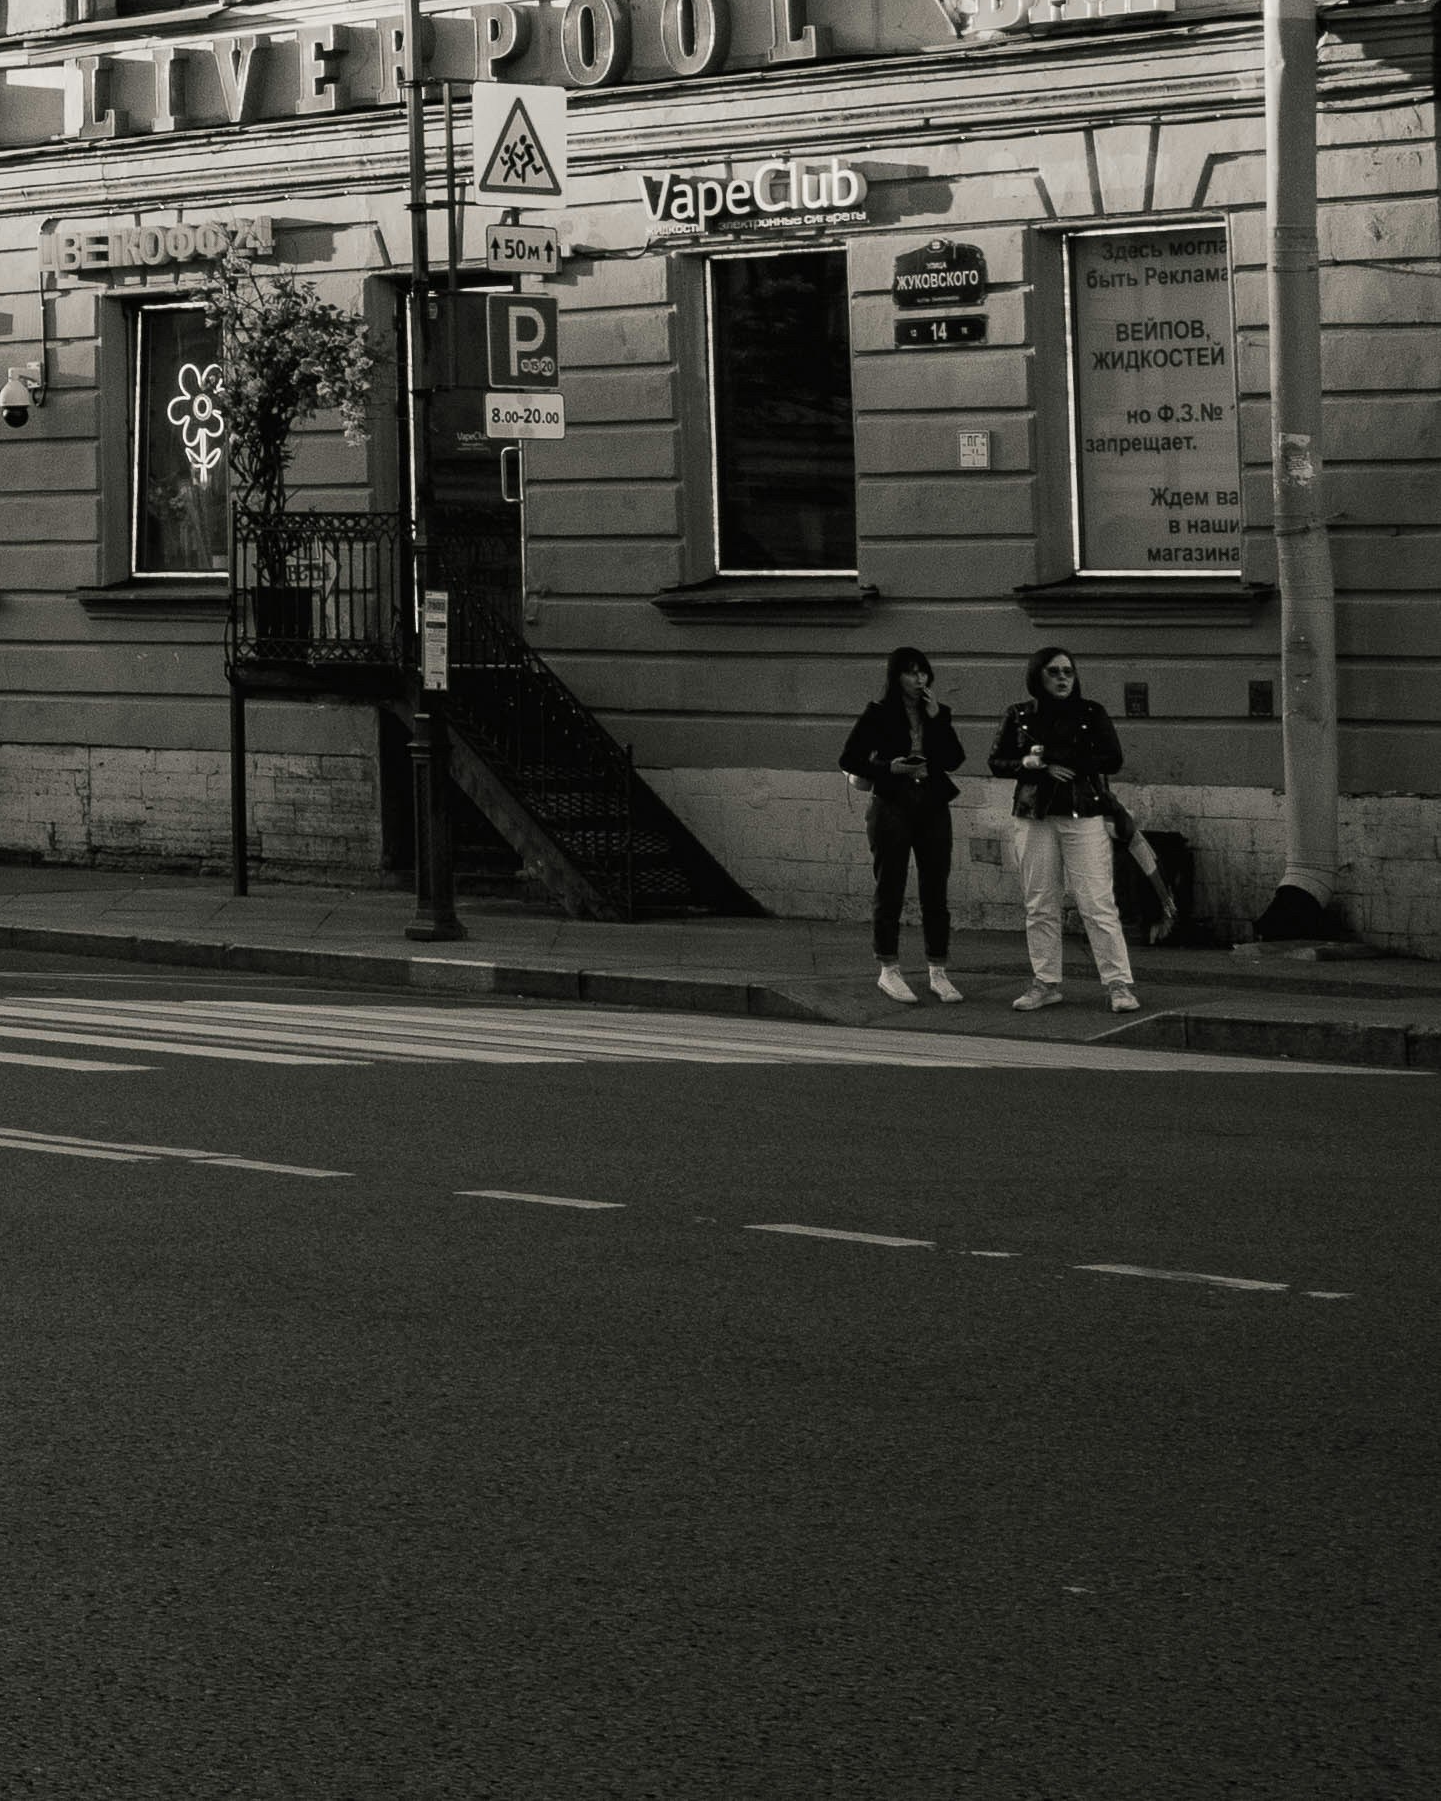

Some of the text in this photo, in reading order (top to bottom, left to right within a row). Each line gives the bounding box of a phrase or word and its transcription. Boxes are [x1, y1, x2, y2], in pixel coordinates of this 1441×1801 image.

[637, 158, 867, 232] VapeClub
[1102, 239, 1227, 263] Здесь могла
[896, 270, 979, 290] ЖУКОВСКОГО
[1087, 267, 1228, 289] быть Реклама
[930, 322, 947, 340] 14
[1116, 317, 1211, 342] ВЕЙПОВ,
[1092, 342, 1225, 372] ЖИДКОСТЕЙ
[1127, 410, 1151, 424] но
[1086, 436, 1197, 456] запрещает.
[1150, 487, 1209, 509] Ждем
[1169, 519, 1180, 534] в
